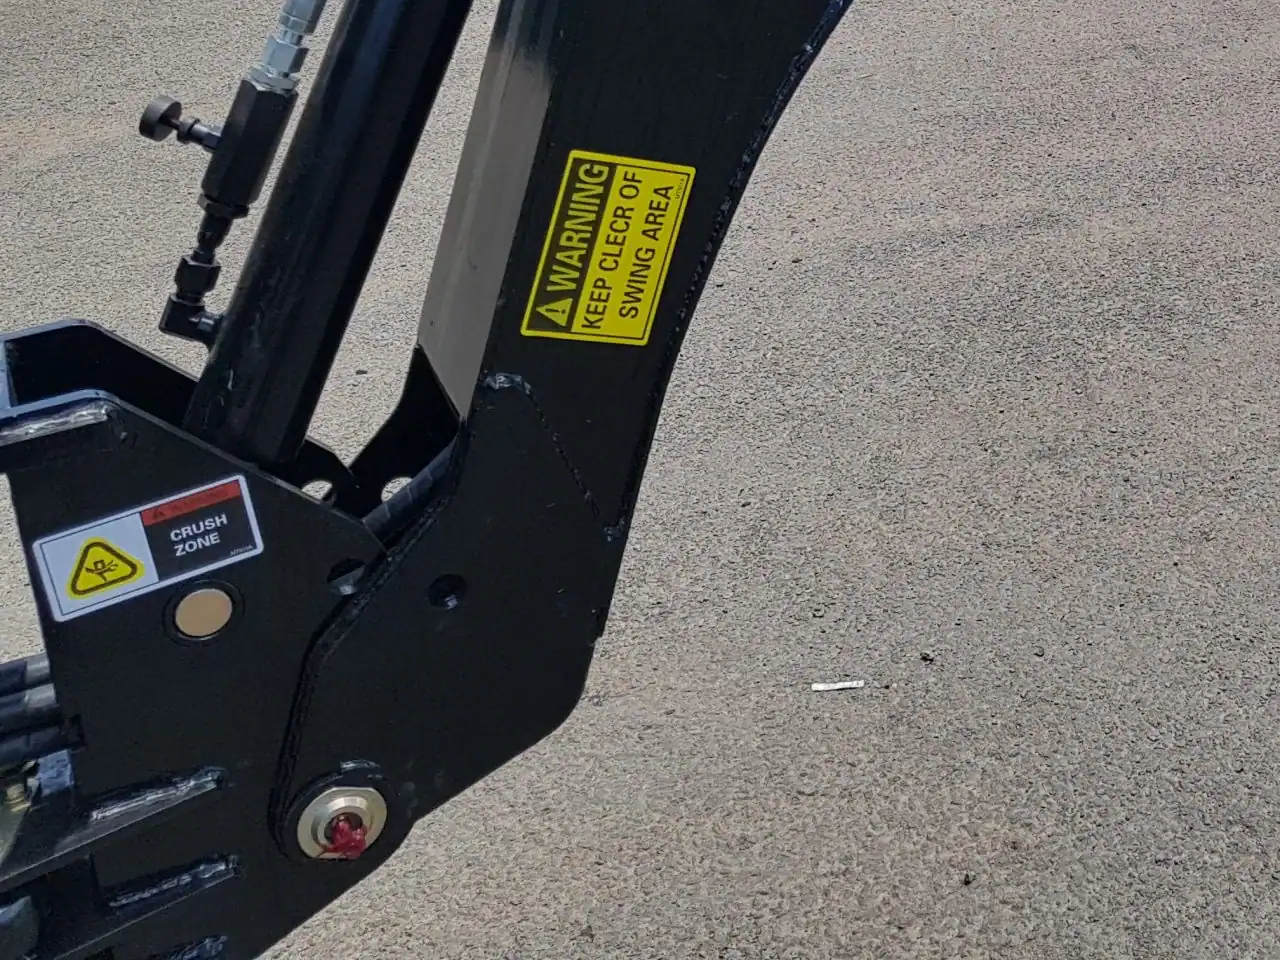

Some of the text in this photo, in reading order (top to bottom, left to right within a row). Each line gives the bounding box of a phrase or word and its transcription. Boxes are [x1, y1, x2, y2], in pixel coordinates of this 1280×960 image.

[547, 163, 610, 292] WARNING
[582, 171, 643, 329] KEEP CLECR OF
[619, 185, 674, 319] SWING AREA
[170, 513, 228, 541] CRUSH
[174, 532, 220, 557] ZONE
